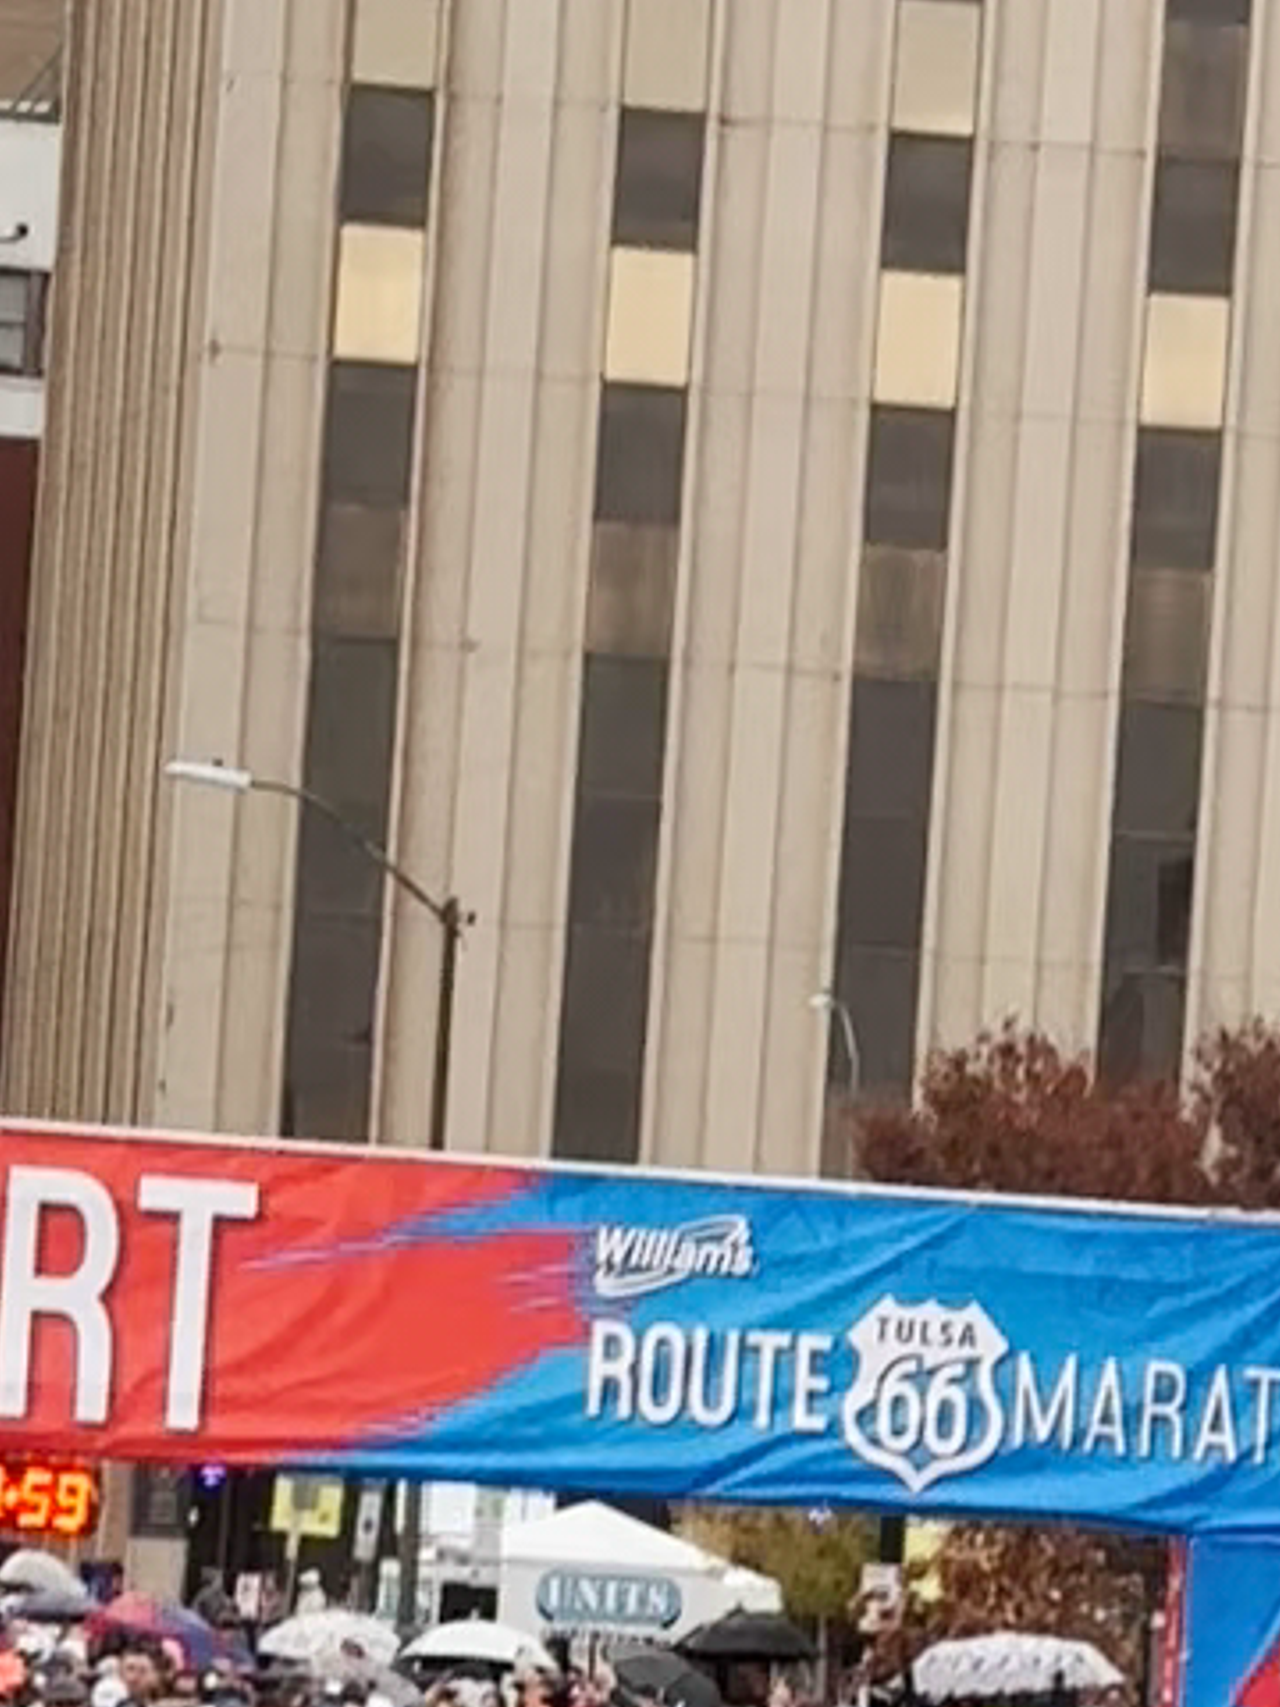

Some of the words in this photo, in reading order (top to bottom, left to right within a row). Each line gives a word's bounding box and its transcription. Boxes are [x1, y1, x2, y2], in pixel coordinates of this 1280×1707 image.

[596, 1223, 755, 1278] Williams
[876, 1315, 979, 1349] TULSA
[586, 1318, 832, 1432] ROUTE
[876, 1354, 981, 1458] 66
[548, 1574, 669, 1617] UNITS
